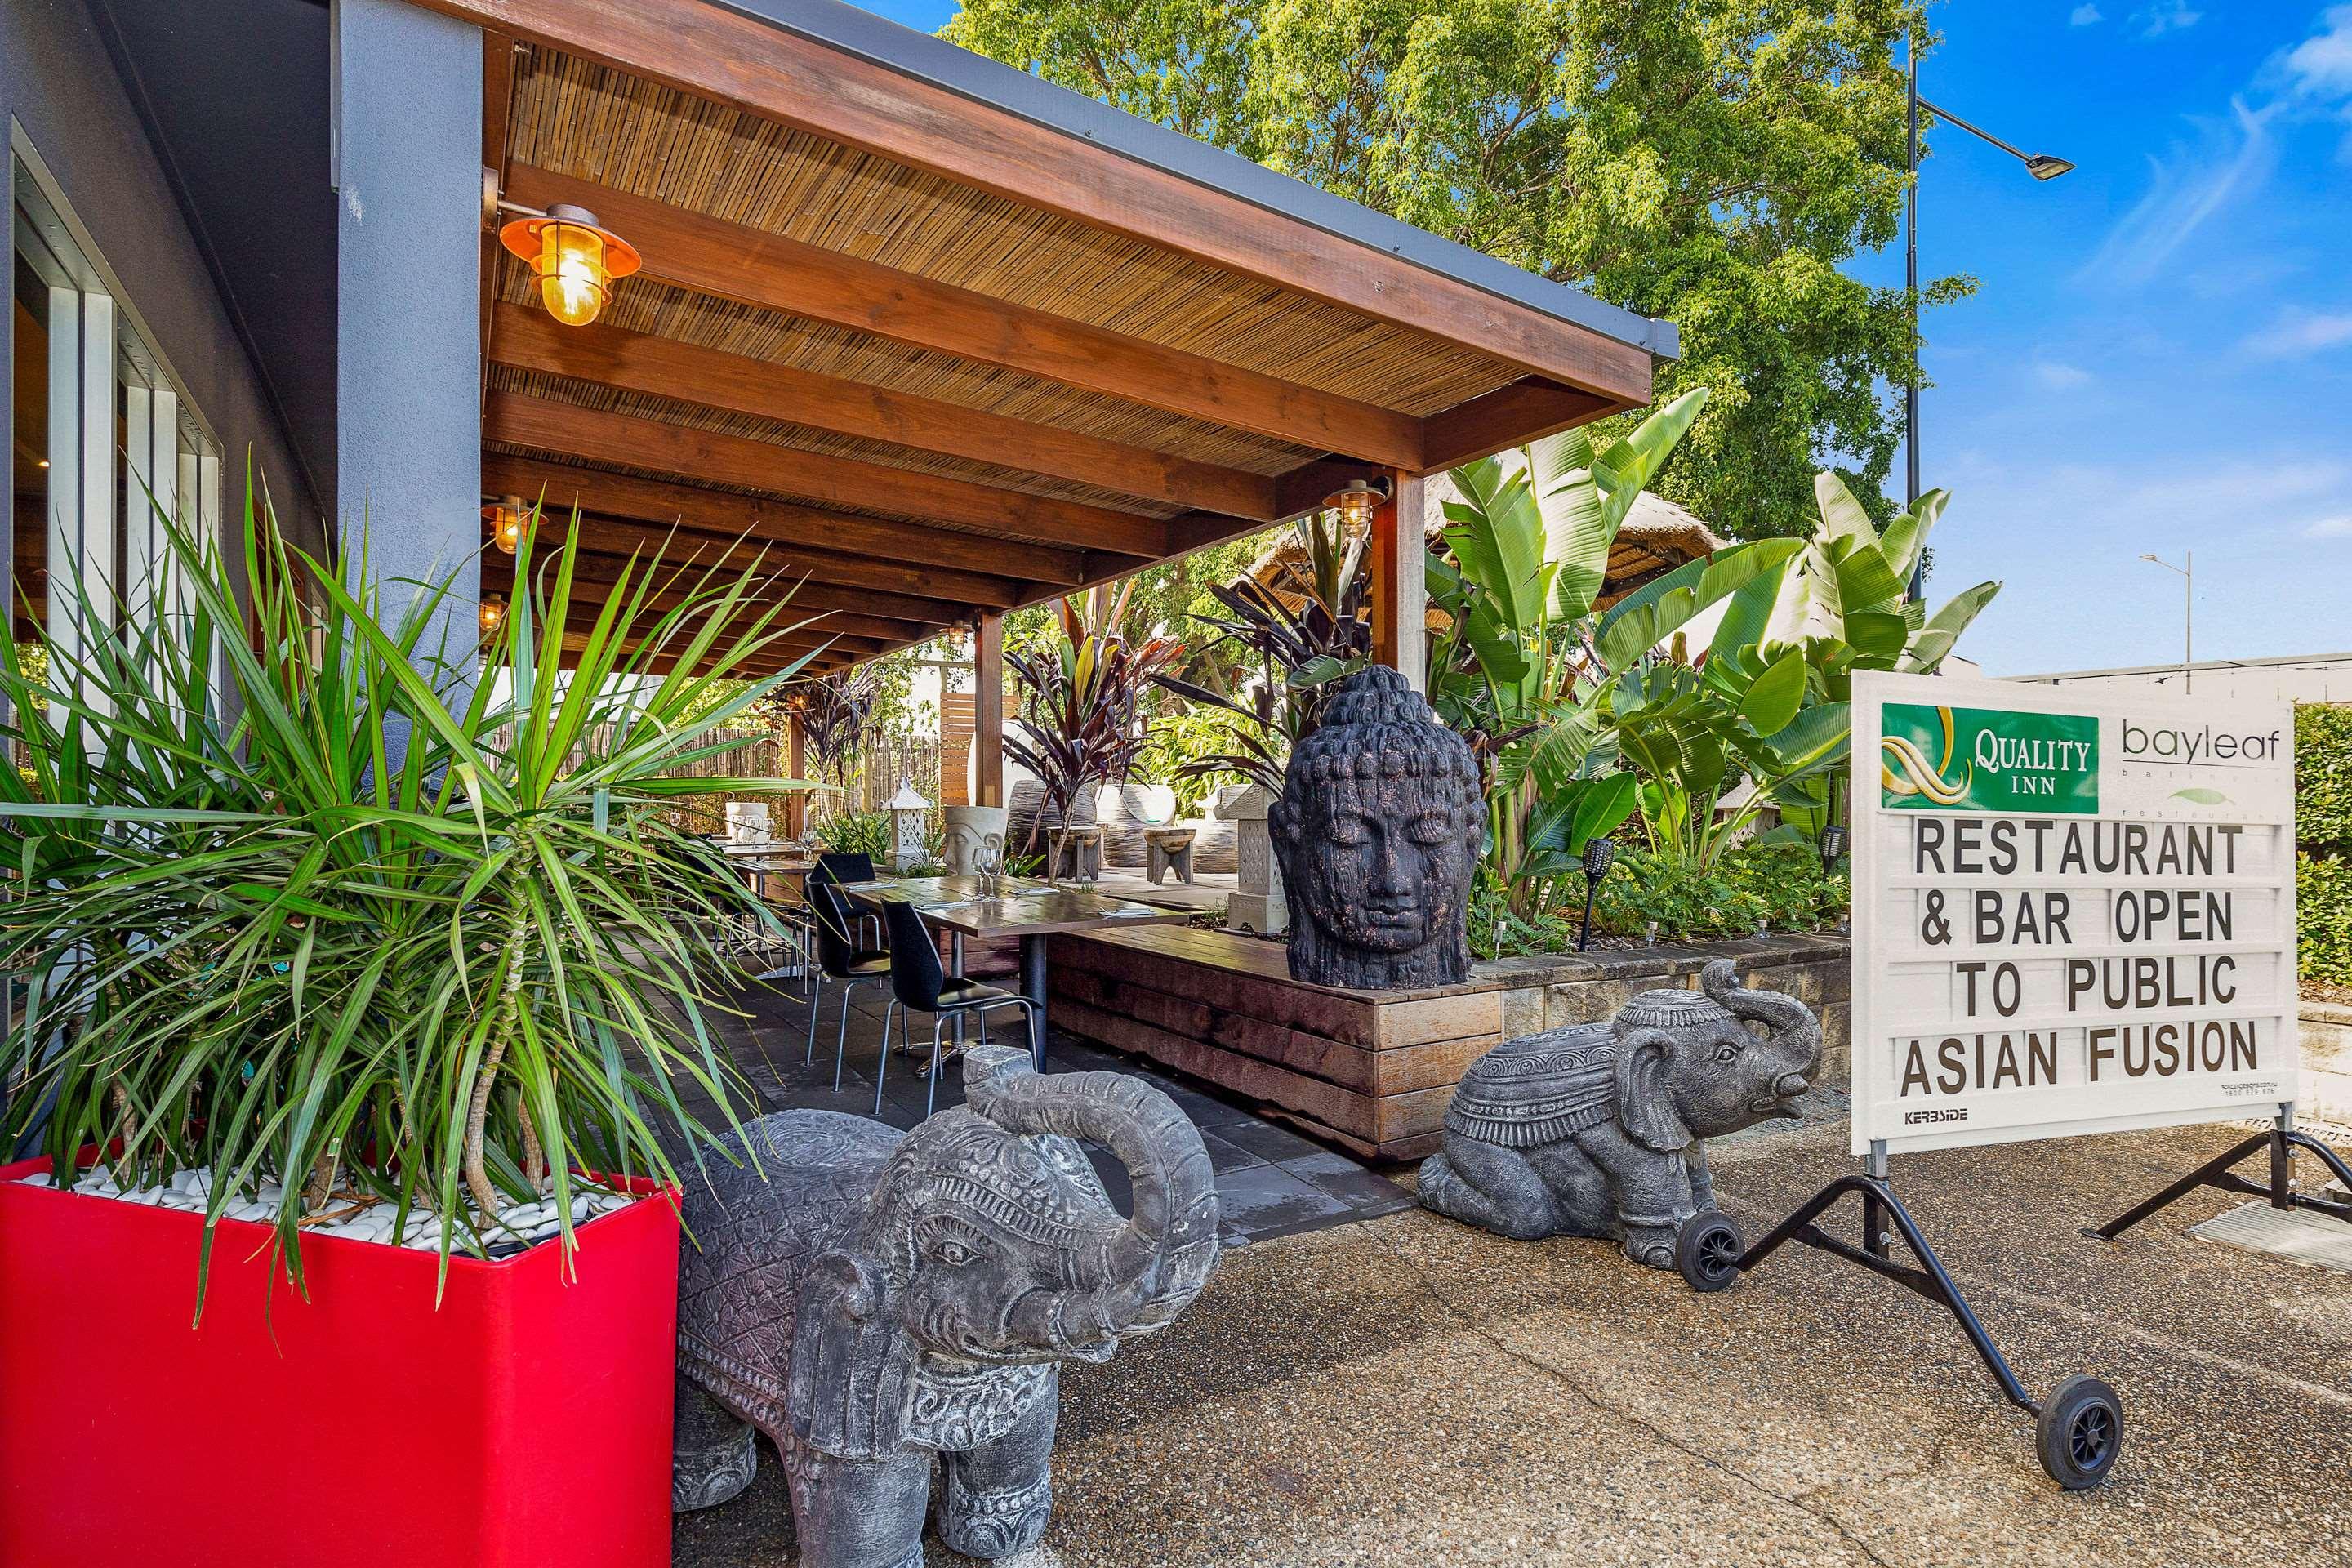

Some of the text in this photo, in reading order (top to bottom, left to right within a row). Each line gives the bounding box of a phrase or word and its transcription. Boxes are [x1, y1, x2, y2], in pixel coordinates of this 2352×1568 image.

[1975, 728, 2091, 774] QUALITY
[2123, 719, 2280, 764] bayleaf
[2011, 775, 2056, 795] INN
[1916, 818, 2243, 875] RESTAURANT
[1922, 889, 2232, 946] & BAR OPEN
[1956, 955, 2236, 1018] TO PUBLIC
[1900, 1021, 2257, 1098] ASIAN FUSION
